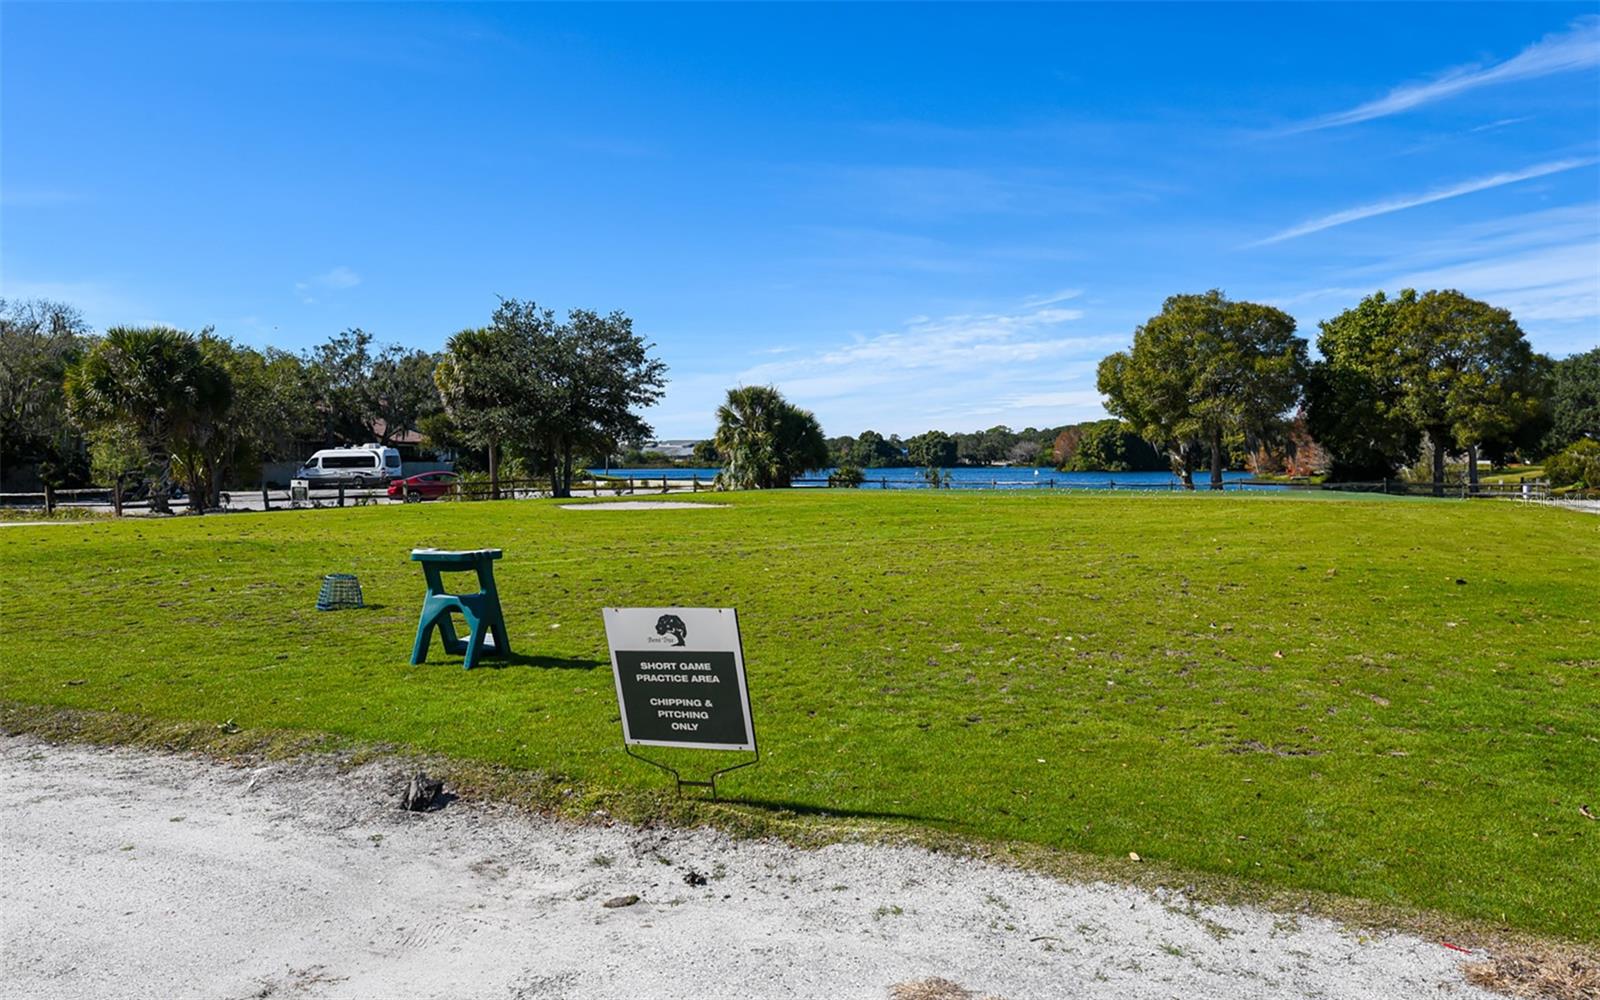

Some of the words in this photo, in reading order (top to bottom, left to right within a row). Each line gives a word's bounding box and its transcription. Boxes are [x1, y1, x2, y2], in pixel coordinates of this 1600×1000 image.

[640, 662, 677, 671] SHORT
[679, 662, 711, 671] GAME
[636, 674, 689, 683] PRACTICE
[691, 674, 720, 683] AREA
[650, 698, 702, 707] CHIPPING
[704, 699, 713, 708] &
[657, 710, 709, 720] PITCHING
[671, 722, 699, 731] ONLY
